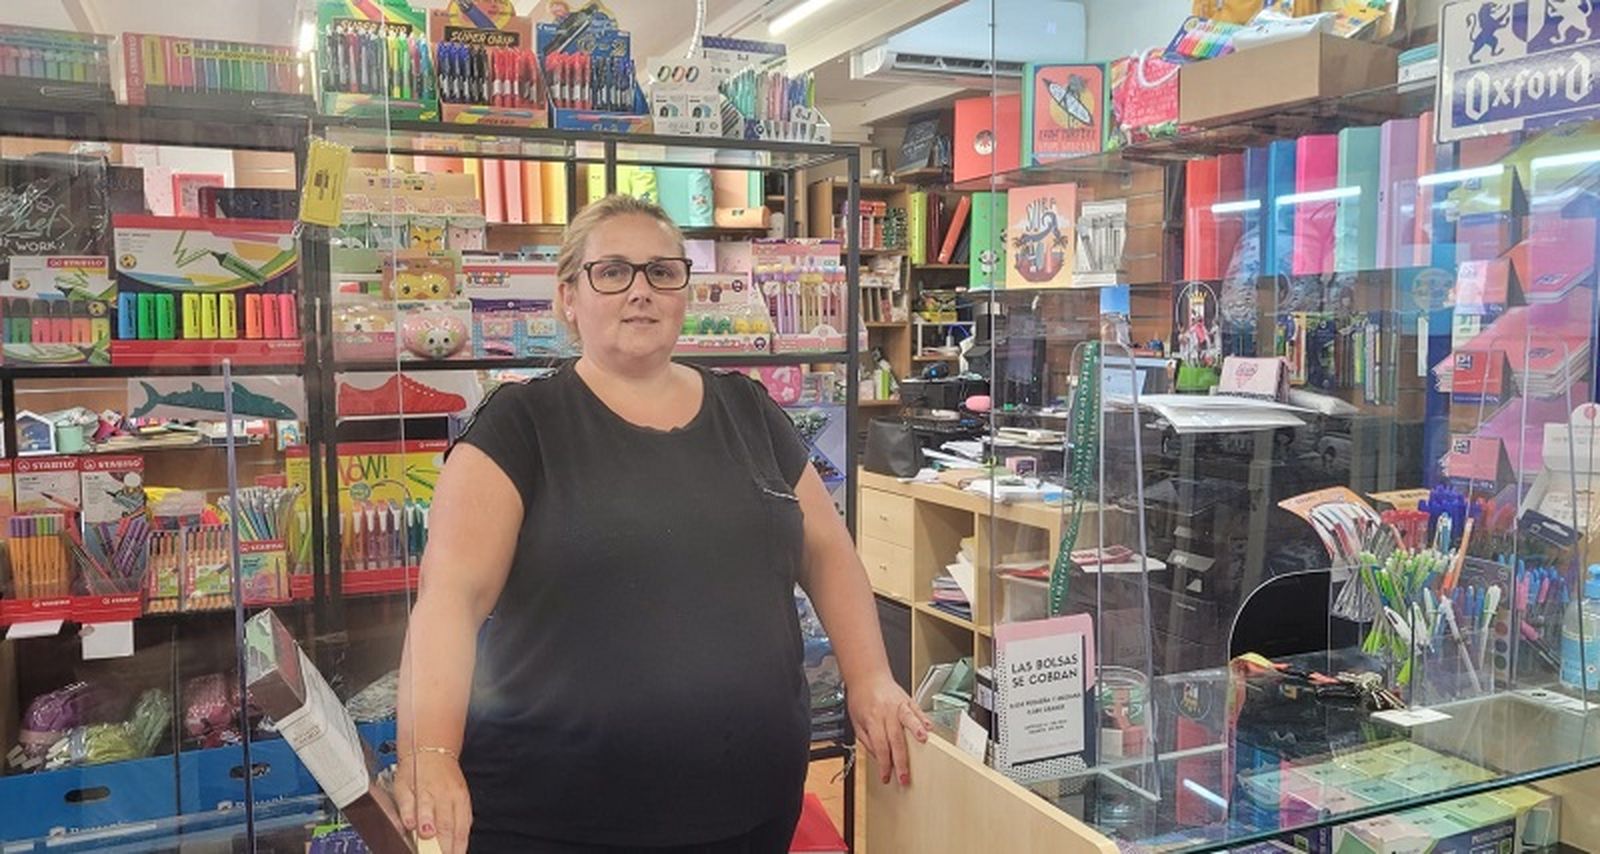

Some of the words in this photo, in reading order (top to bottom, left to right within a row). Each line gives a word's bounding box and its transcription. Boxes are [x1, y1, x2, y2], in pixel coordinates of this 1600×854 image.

[450, 31, 486, 42] SUPER
[175, 43, 190, 55] 15
[1465, 52, 1592, 120] Oxford
[15, 241, 57, 251] WORK
[32, 461, 75, 469] STABILO
[98, 460, 140, 469] STABILO
[1011, 661, 1033, 674] LAS
[1036, 653, 1079, 670] BOLSAS
[1012, 677, 1024, 688] SE
[1029, 669, 1077, 685] COBRAN
